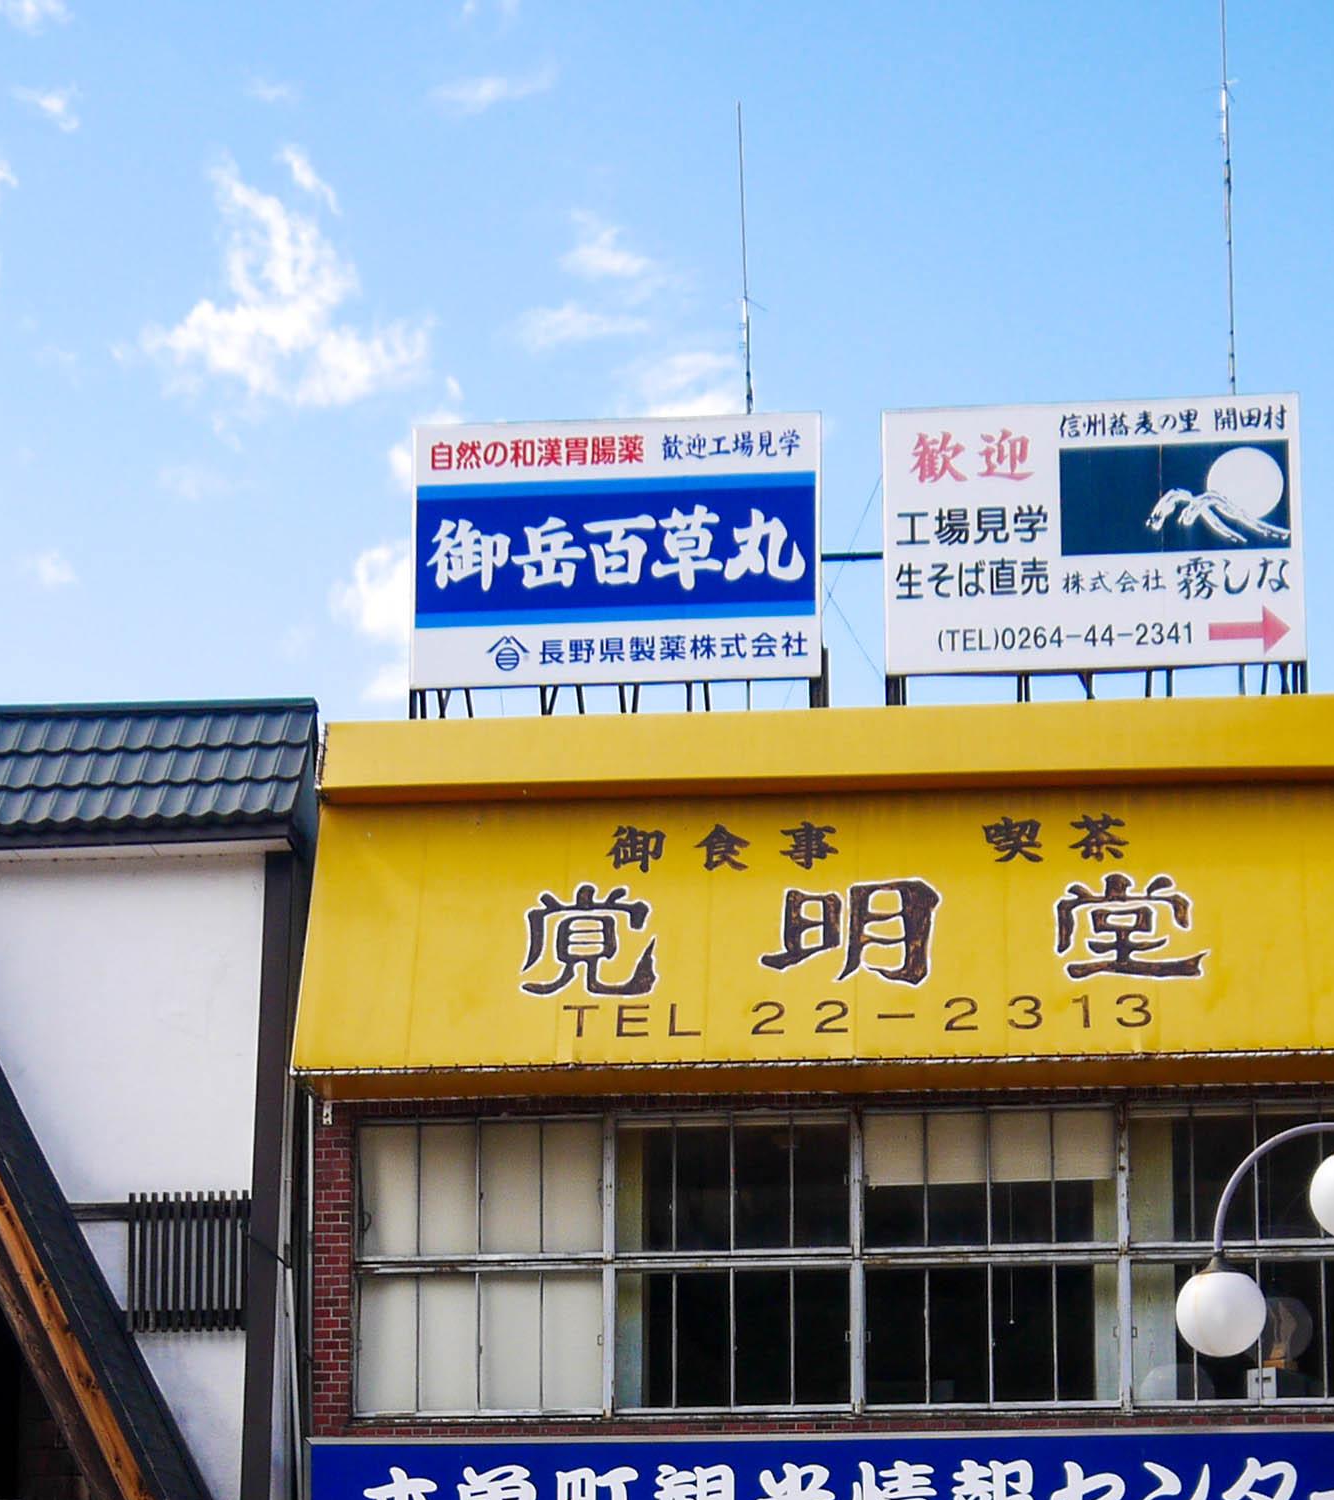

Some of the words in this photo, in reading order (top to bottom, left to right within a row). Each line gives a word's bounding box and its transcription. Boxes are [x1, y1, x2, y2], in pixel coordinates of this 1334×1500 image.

[1059, 408, 1201, 438] 信州蕎麦の里
[1214, 405, 1288, 432] 開田村
[430, 434, 644, 471] 自然の和漢胃腸薬
[662, 429, 801, 461] 歓迎工場見学
[910, 427, 1036, 485] 歓迎
[896, 504, 1049, 547] 工場見学
[427, 504, 806, 592] 御岳百草丸
[895, 556, 1050, 601] 生そば直売
[1062, 569, 1167, 595] 株式会社
[1176, 557, 1291, 601] 霧しな
[539, 631, 809, 666] 長野県製薬株式会社
[937, 621, 1195, 653] (TEL)0264-44-2341
[606, 822, 838, 872] 御食事
[981, 813, 1129, 864] 喫茶
[519, 871, 1208, 998] 覚明堂
[562, 1003, 703, 1039] TEL
[750, 992, 1155, 1037] 22-2313
